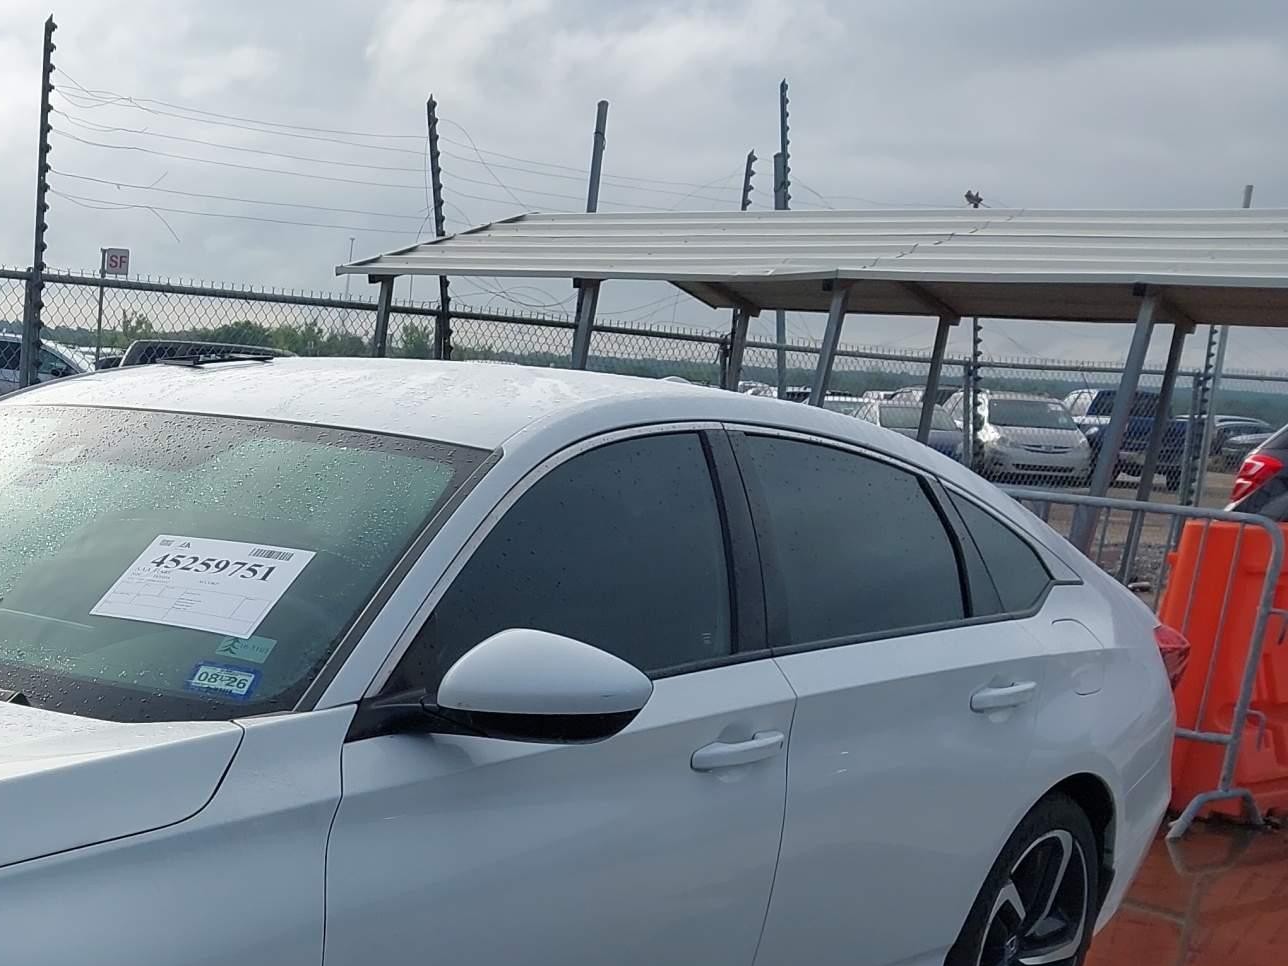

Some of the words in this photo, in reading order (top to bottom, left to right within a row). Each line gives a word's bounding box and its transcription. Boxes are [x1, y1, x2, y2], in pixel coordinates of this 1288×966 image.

[109, 254, 128, 269] SF
[151, 553, 278, 582] 45259751
[198, 671, 219, 684] 08
[225, 676, 249, 690] 26
